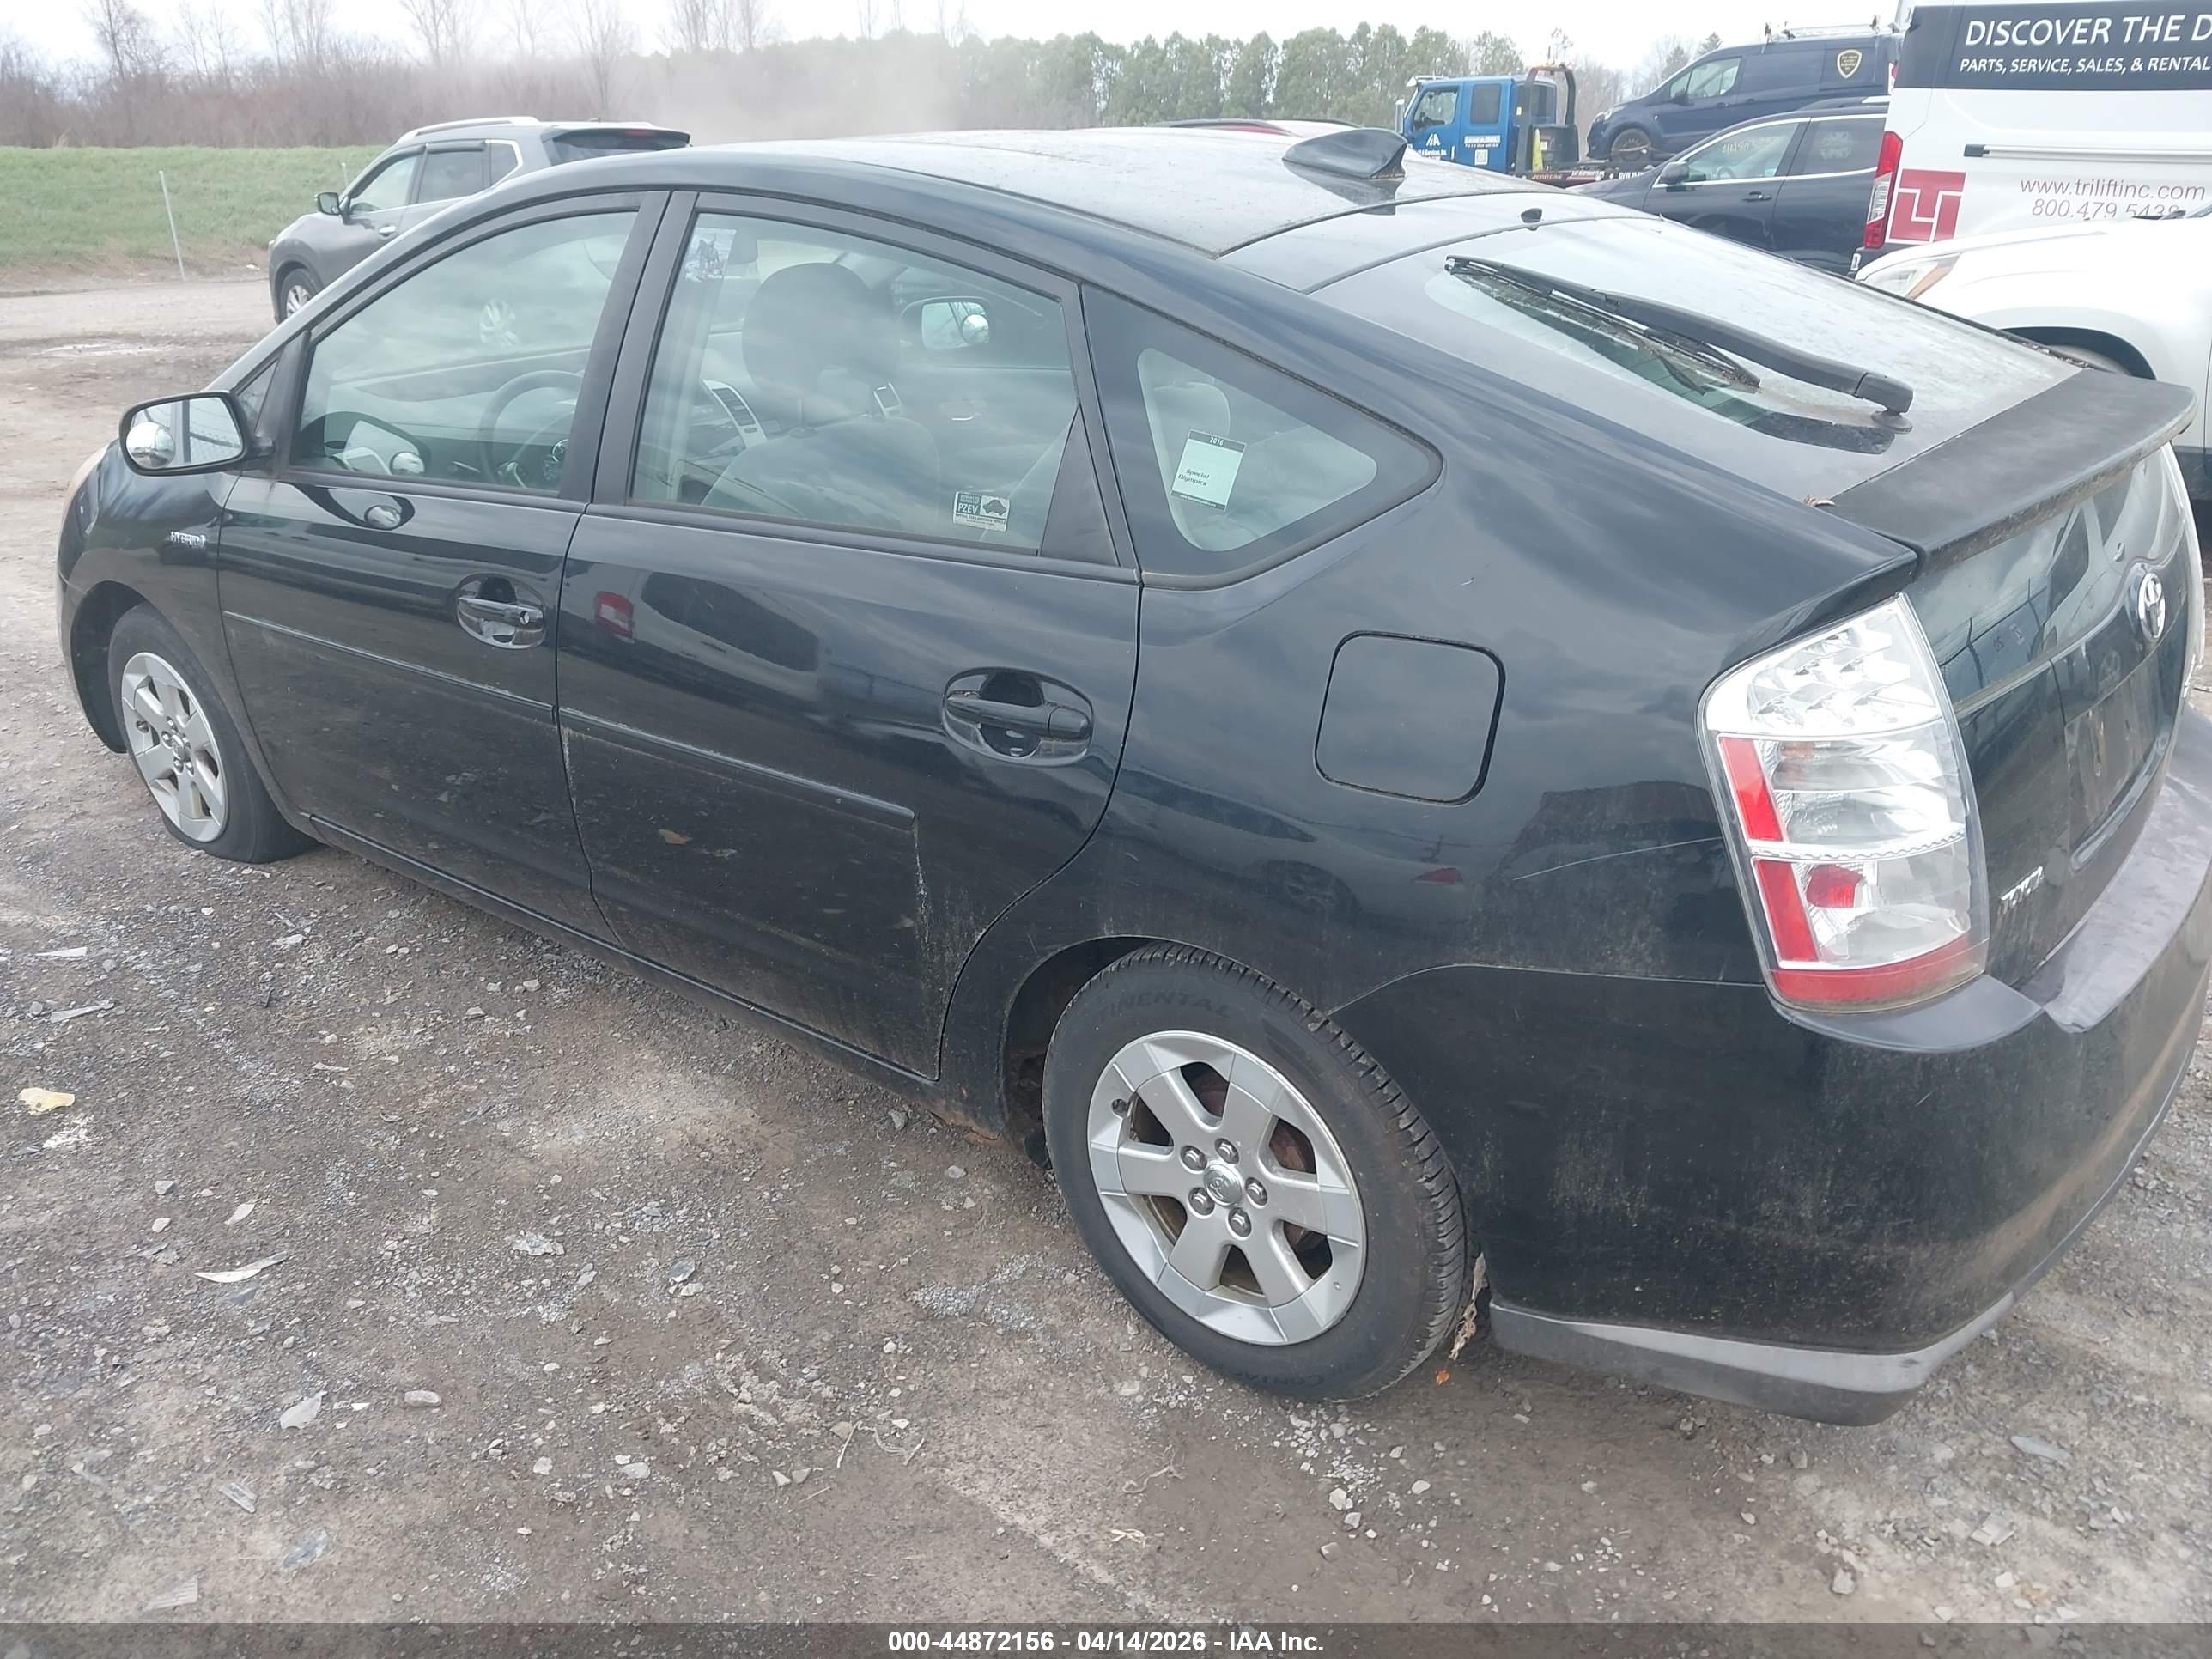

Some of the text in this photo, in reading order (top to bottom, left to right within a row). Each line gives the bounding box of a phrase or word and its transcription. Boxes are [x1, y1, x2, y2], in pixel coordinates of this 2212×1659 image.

[1965, 18, 2112, 46] DISCOVER
[2123, 15, 2186, 44] THE
[1959, 56, 2211, 76] PARTS, SERVICE, SALES, & RENTAL
[2020, 178, 2206, 201] www.triliftinc.com
[1209, 436, 1224, 447] 2016
[1177, 473, 1207, 487] Olympics
[1186, 468, 1210, 479] Special
[957, 502, 979, 514] PZEV
